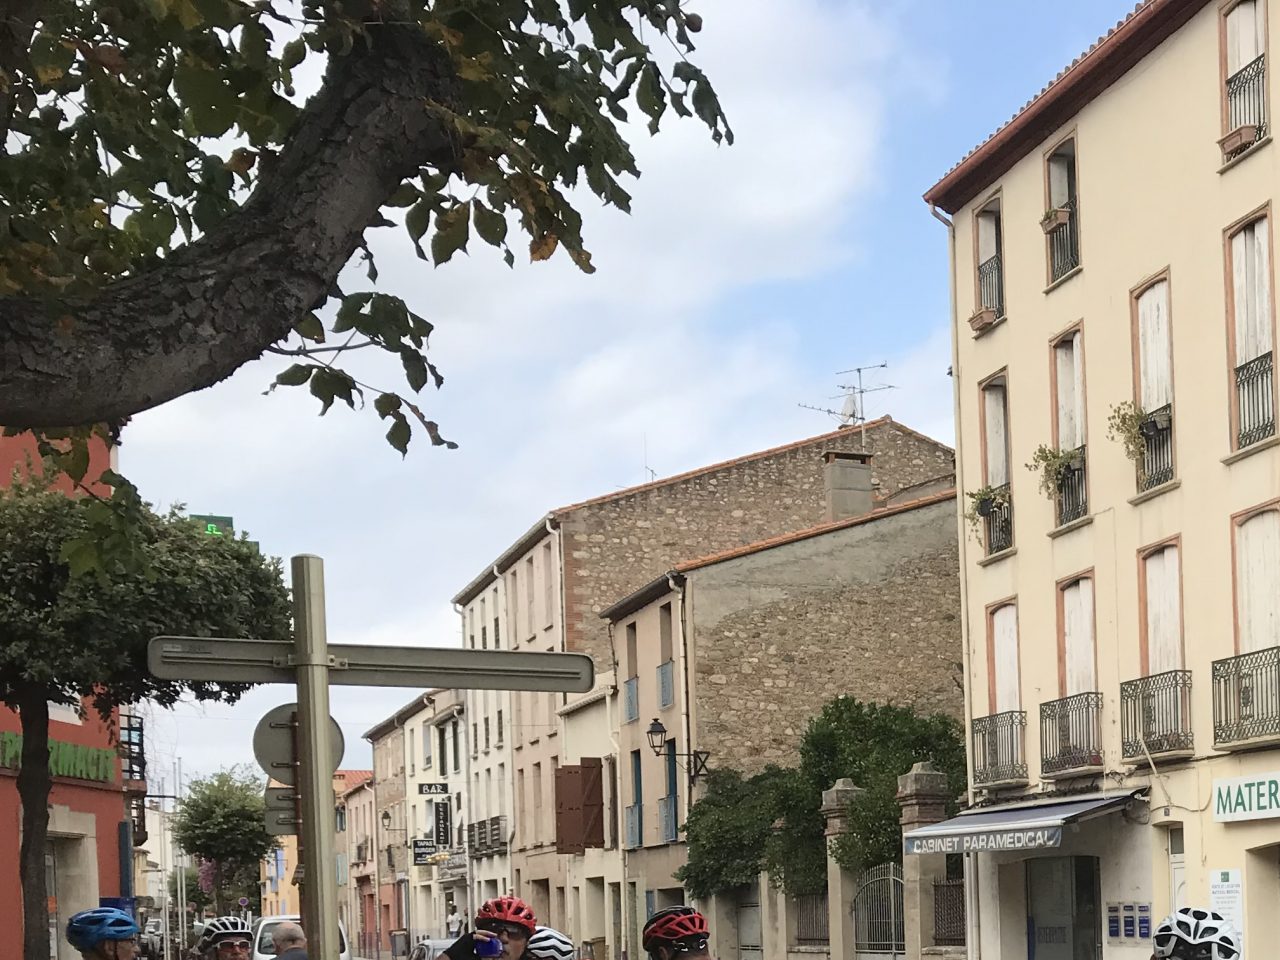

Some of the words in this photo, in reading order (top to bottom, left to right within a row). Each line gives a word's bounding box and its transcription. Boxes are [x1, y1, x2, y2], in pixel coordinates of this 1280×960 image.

[422, 785, 444, 793] BAR
[913, 837, 960, 853] CABINET
[963, 830, 1056, 850] PARAMEDICAL
